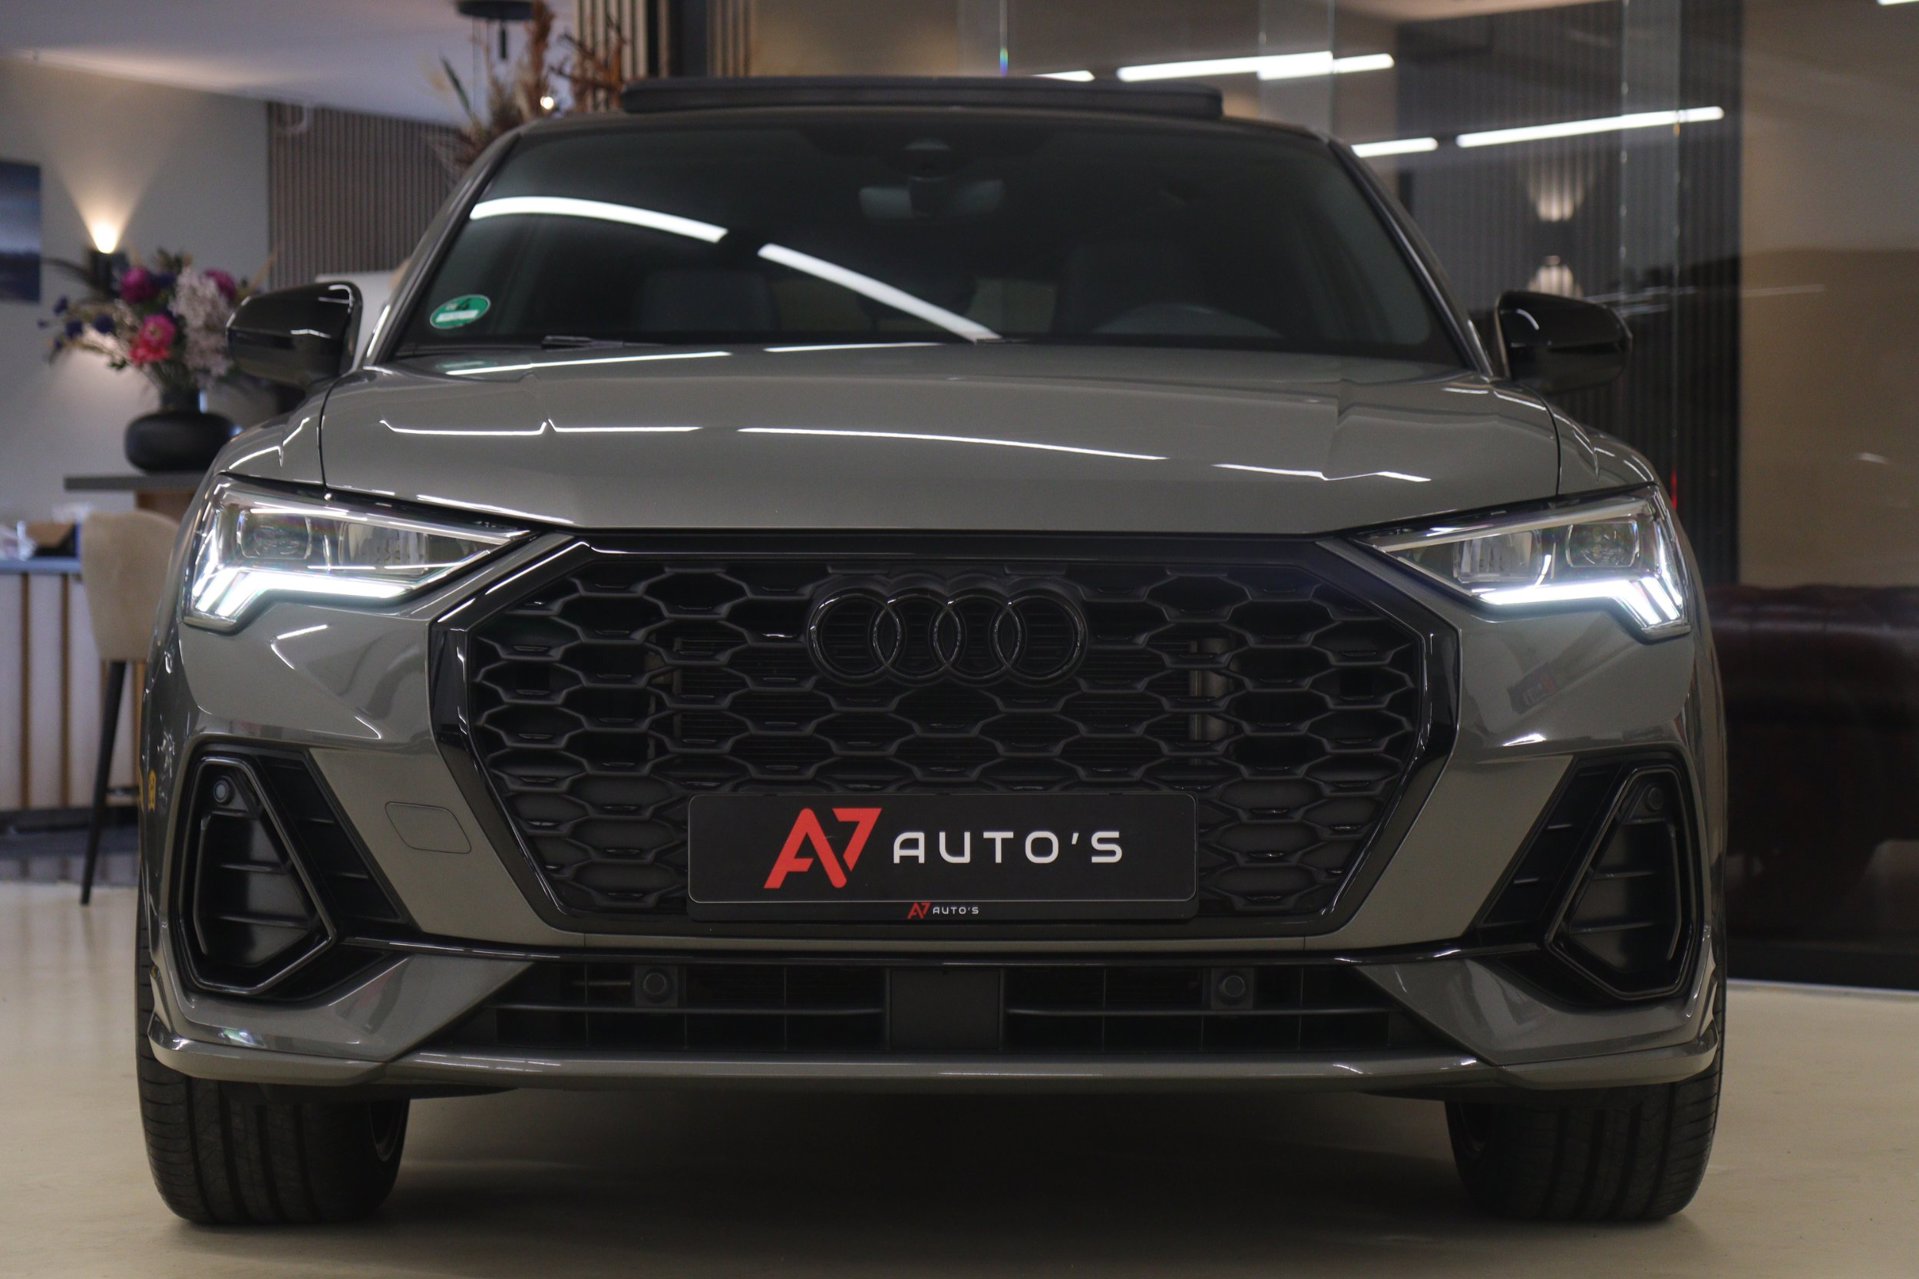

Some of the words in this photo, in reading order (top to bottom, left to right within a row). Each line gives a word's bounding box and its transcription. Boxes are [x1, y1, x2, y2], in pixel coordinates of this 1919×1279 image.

[764, 807, 882, 889] A7
[893, 830, 1123, 864] AUTO'S
[907, 901, 931, 919] A7
[932, 906, 980, 915] AUTO'S
